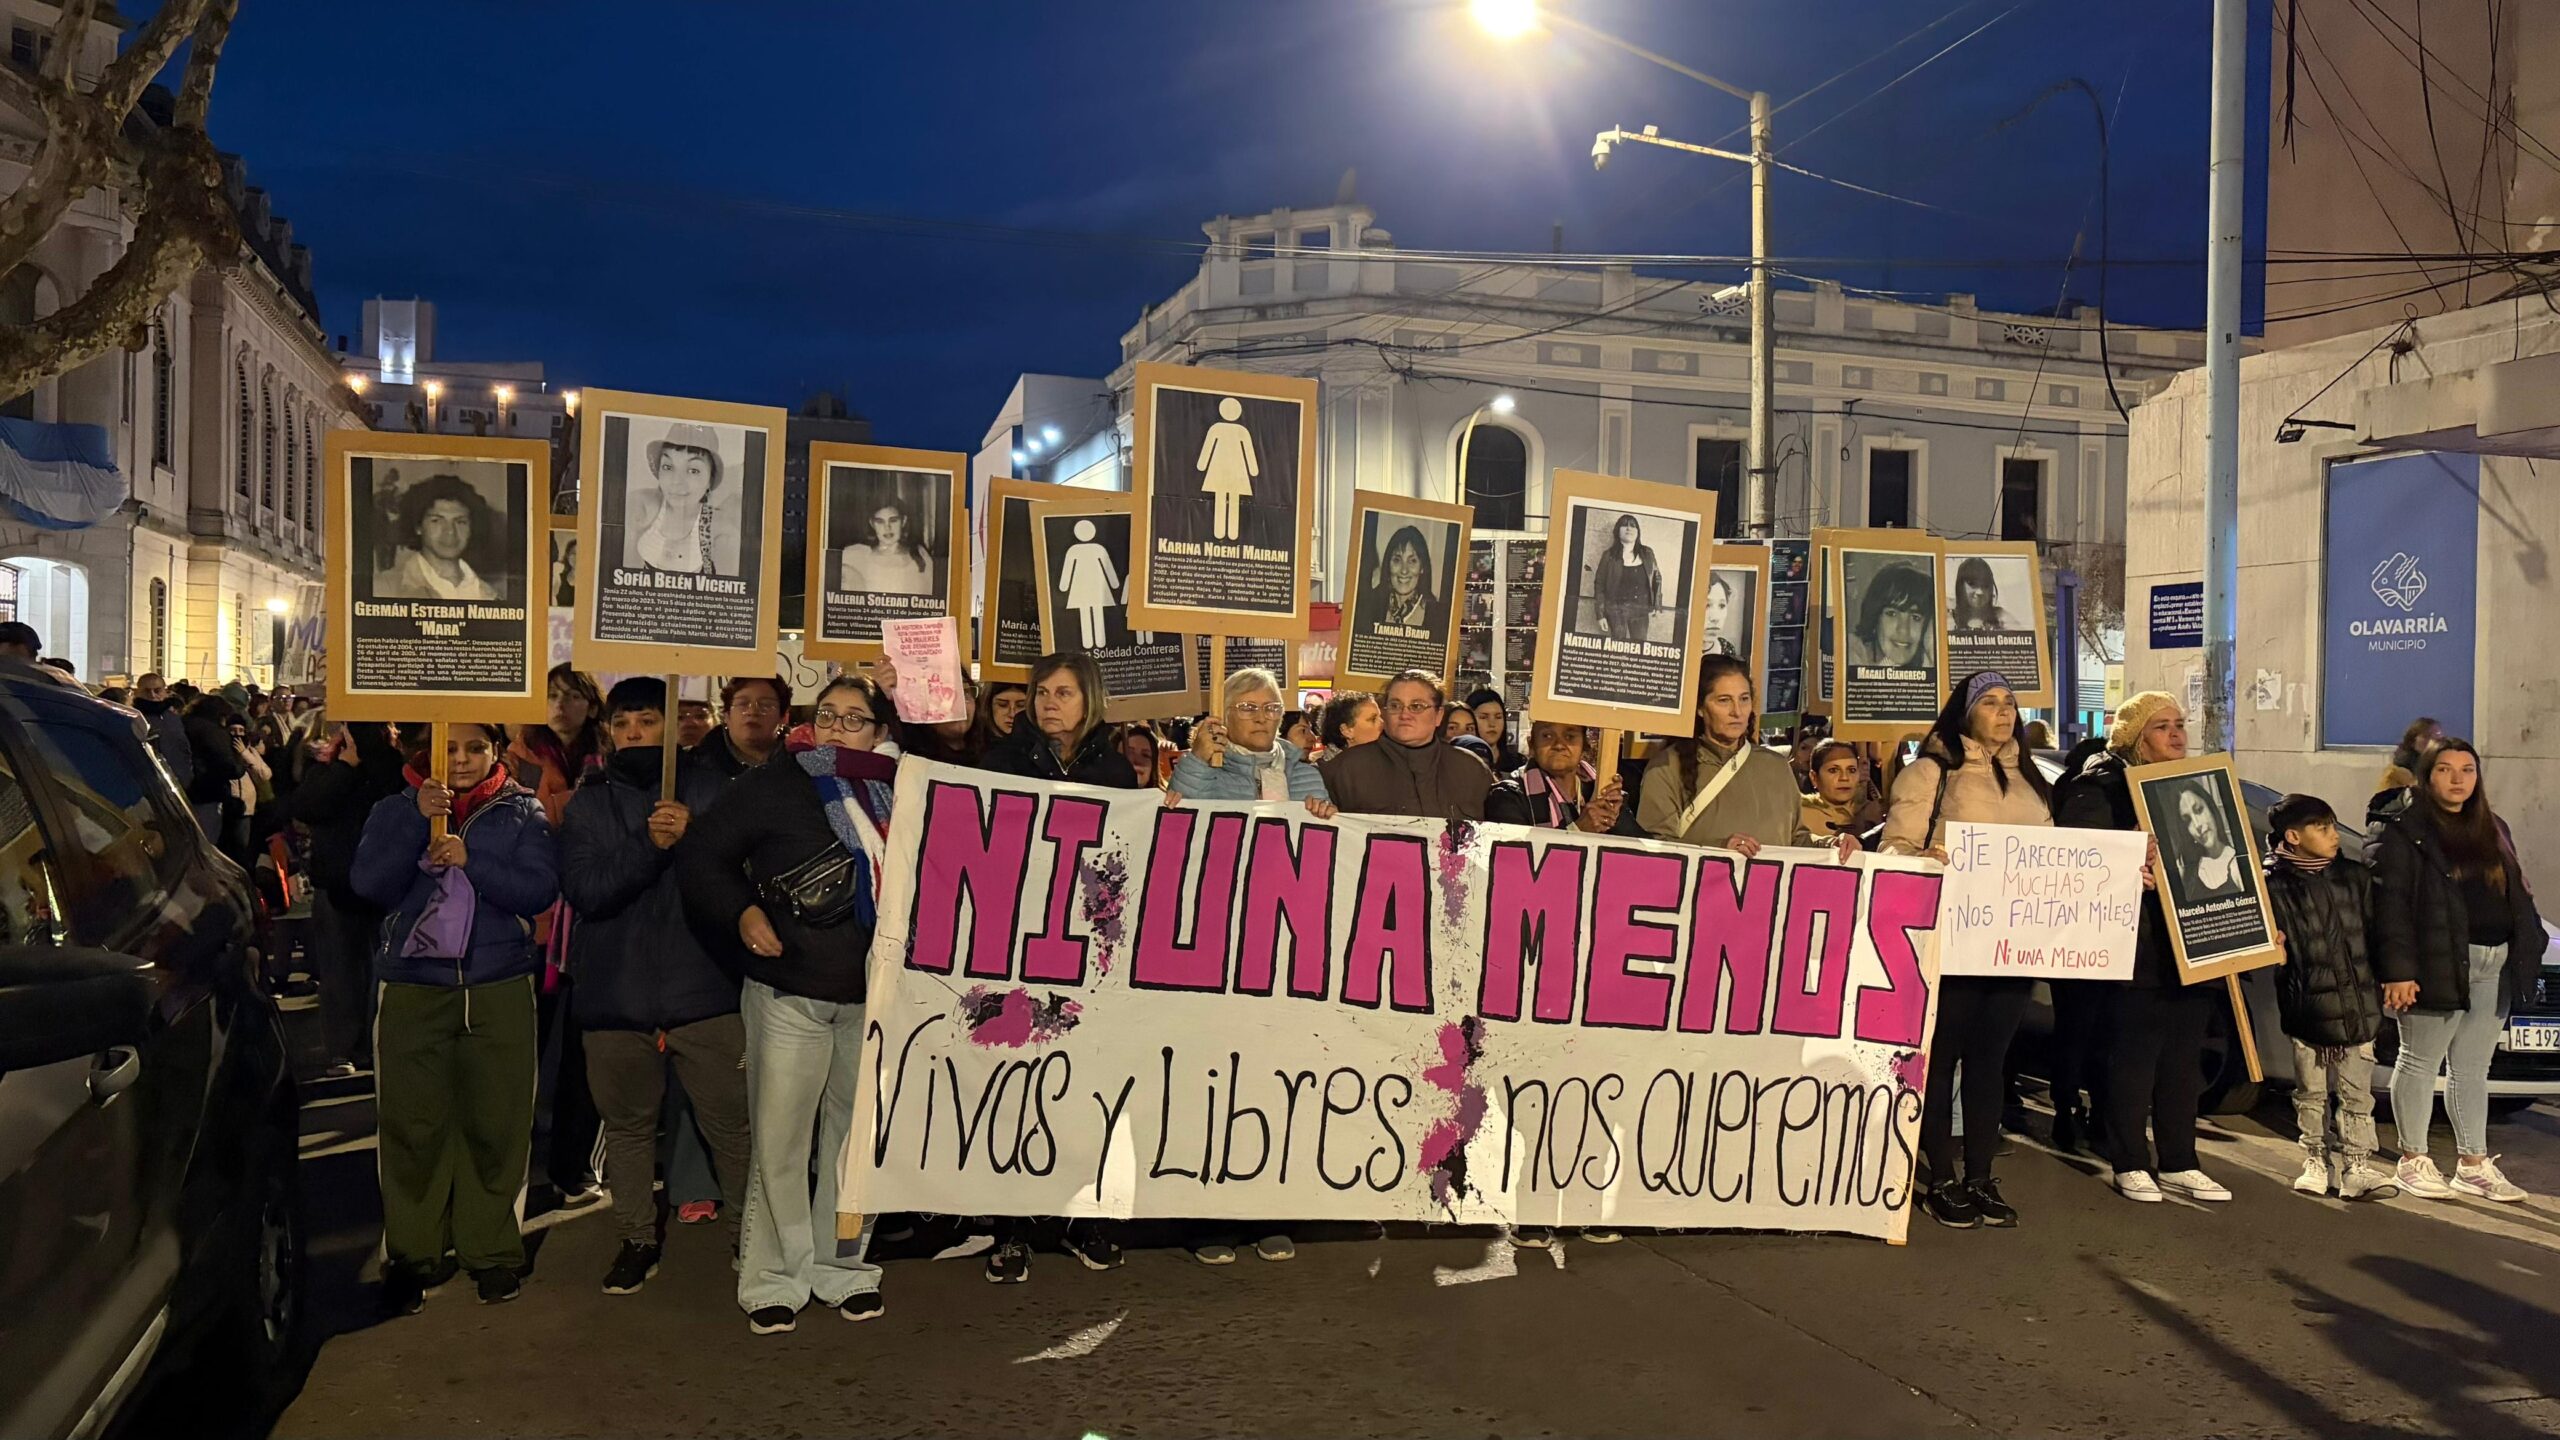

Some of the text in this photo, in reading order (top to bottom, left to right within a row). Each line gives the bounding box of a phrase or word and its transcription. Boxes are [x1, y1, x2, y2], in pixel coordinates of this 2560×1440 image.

[1158, 538, 1288, 562] KARINA NOEMÍ MAIRANI
[613, 569, 747, 595] SOFÍA BELÉN VICENTE
[355, 601, 524, 620] GERMÁN ESTEBAN NAVARRO
[827, 592, 945, 610] VALERIA SOLEDAD CAZOLA
[1001, 619, 1028, 631] María
[1374, 622, 1430, 640] TAMARA BRAVO
[2350, 612, 2448, 636] OLAVARRÍA
[1564, 632, 1681, 659] NATALIA ANDREA BUSTOS
[1997, 635, 2032, 645] GONZÁLEZ
[2368, 639, 2426, 652] MUNICIPIO
[1093, 645, 1132, 659] Soledad
[1134, 644, 1180, 656] Contreras
[1857, 667, 1885, 679] MAGALÍ
[1951, 825, 2103, 872] ¿TE PARECEMOS
[904, 780, 1943, 1048] NI UNA MENOS
[2009, 897, 2079, 928] FALTAN
[2178, 896, 2257, 918] Marcela Antonella Gómez
[2017, 949, 2044, 966] UNA
[2051, 947, 2109, 968] MENOS
[2515, 1028, 2560, 1047] AE 192
[867, 1013, 1071, 1177] Vivas
[1149, 1046, 1412, 1192] Libres
[1501, 1072, 1624, 1193] nos
